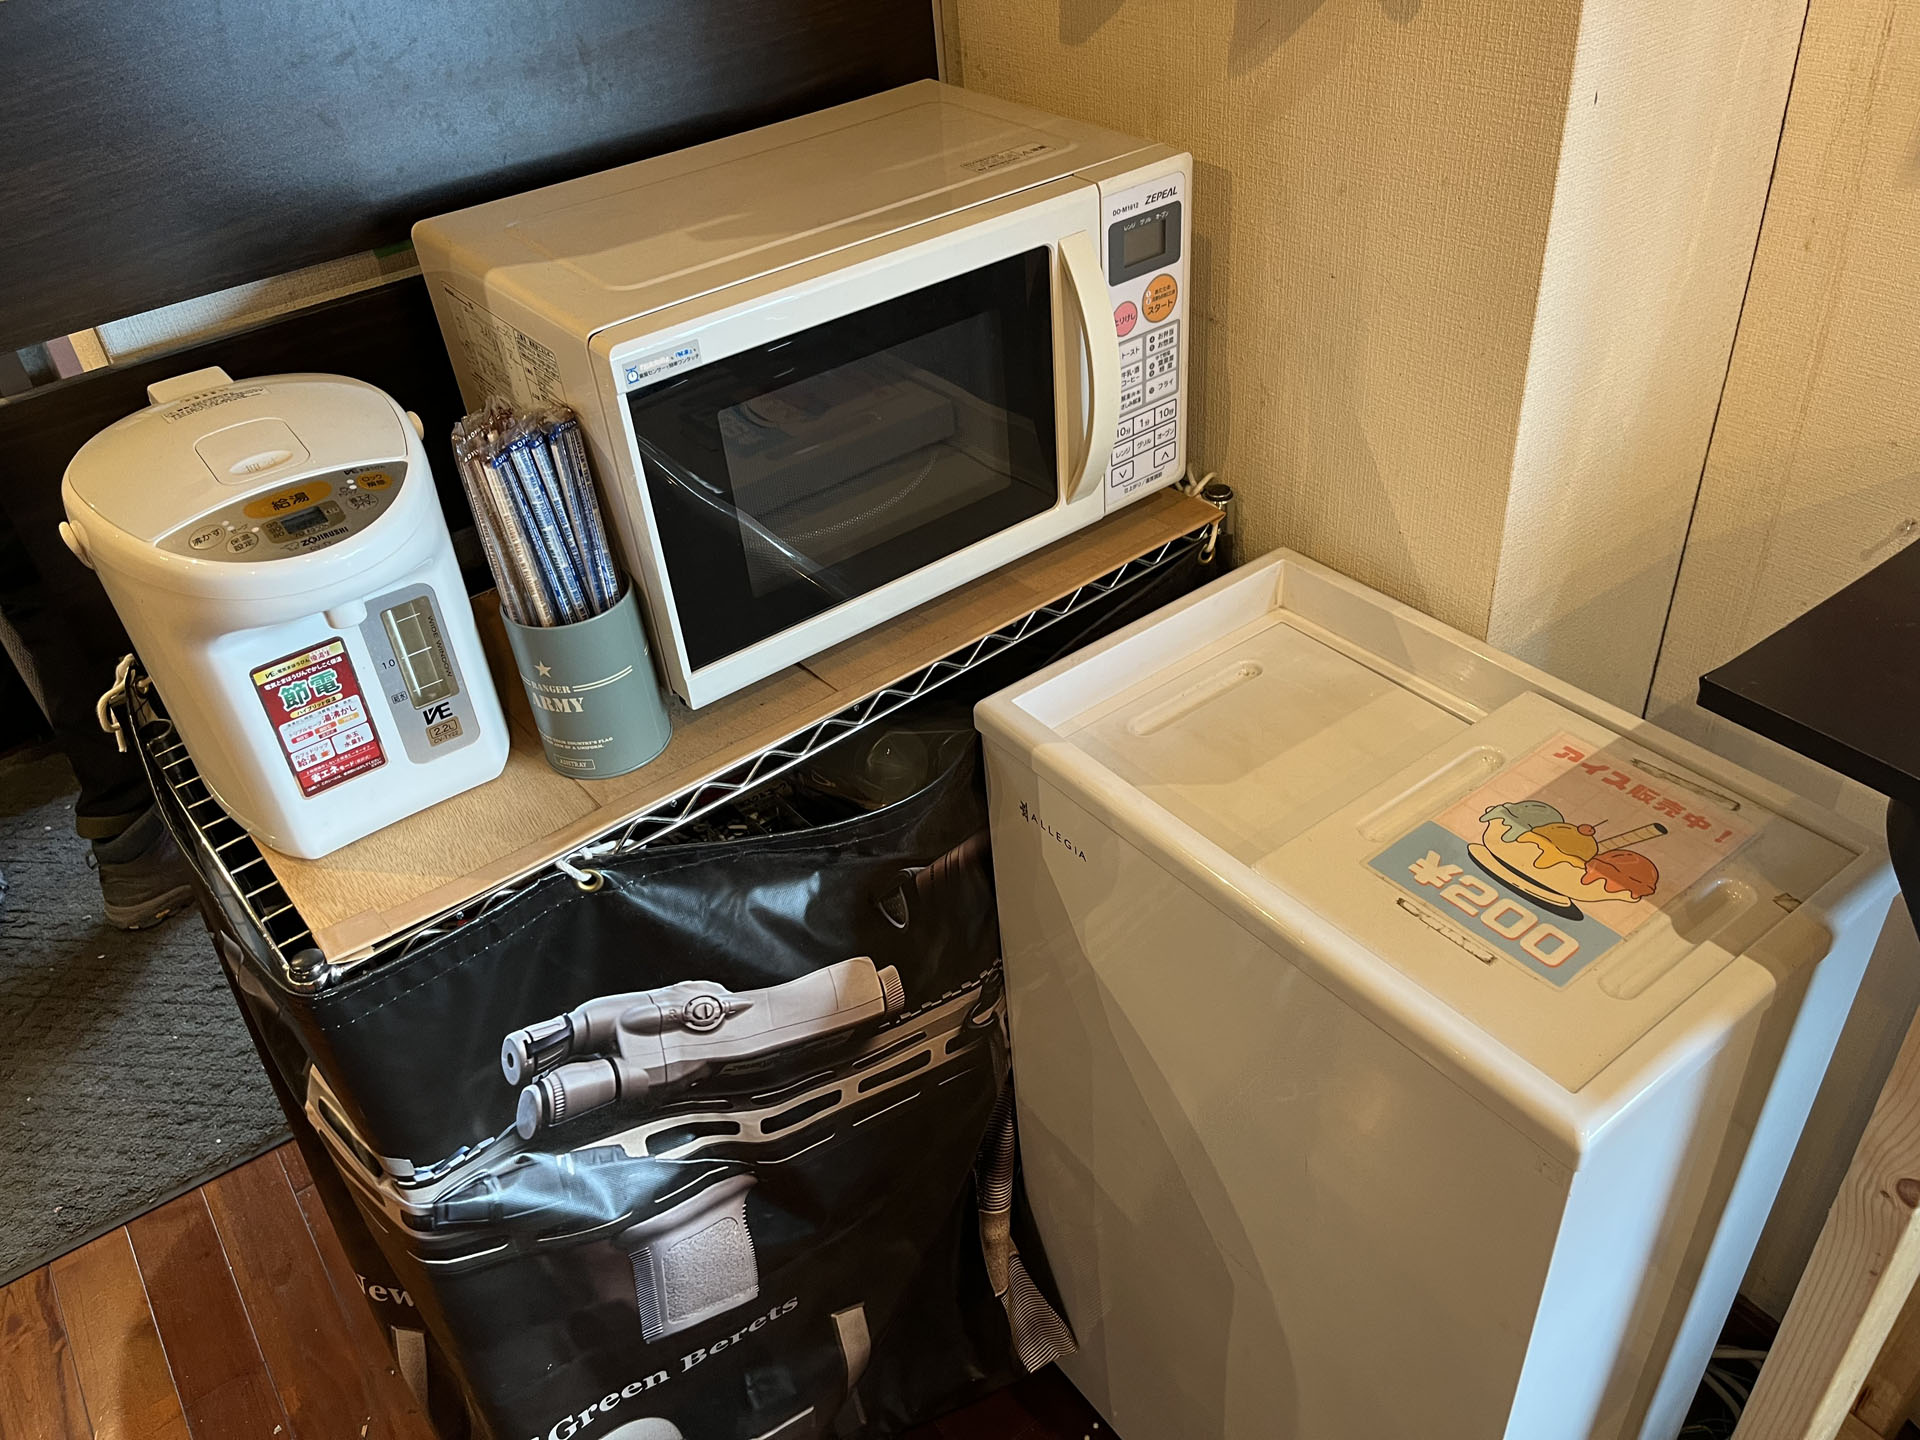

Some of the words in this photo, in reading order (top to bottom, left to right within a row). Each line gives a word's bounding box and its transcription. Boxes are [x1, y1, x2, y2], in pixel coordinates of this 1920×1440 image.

[1145, 186, 1178, 205] ZEPEAL
[1147, 299, 1173, 316] スタート
[1121, 347, 1140, 360] トースト
[1121, 375, 1140, 387] コーヒー
[1158, 378, 1174, 390] フライ
[1116, 447, 1131, 459] レンジ
[1137, 438, 1152, 449] グリル
[1157, 428, 1174, 440] オーブン
[361, 474, 382, 482] ロック
[271, 491, 310, 511] 給湯
[553, 499, 567, 526] DELICIOUS
[563, 526, 572, 539] MEAL
[192, 527, 220, 547] 沸かす
[230, 533, 251, 546] 保温
[301, 526, 349, 547] ZOJIRUSHI
[503, 514, 519, 543] DELICIOUS
[513, 542, 524, 557] MEAL
[523, 570, 538, 597] PLEASURE
[427, 615, 439, 638] WIDE
[435, 640, 453, 678] WINDOW
[382, 658, 396, 671] 1.0
[279, 669, 342, 711] 節電
[531, 680, 571, 694] RANGER
[296, 696, 337, 716] ハイブリッド保温
[533, 691, 584, 713] ARMY
[598, 736, 614, 744] FLAG
[310, 762, 355, 784] 省エネモード
[1031, 813, 1087, 862] ALLEGIA
[1408, 850, 1580, 968] ¥200
[547, 1369, 671, 1440] Green
[680, 1296, 799, 1374] Berets
